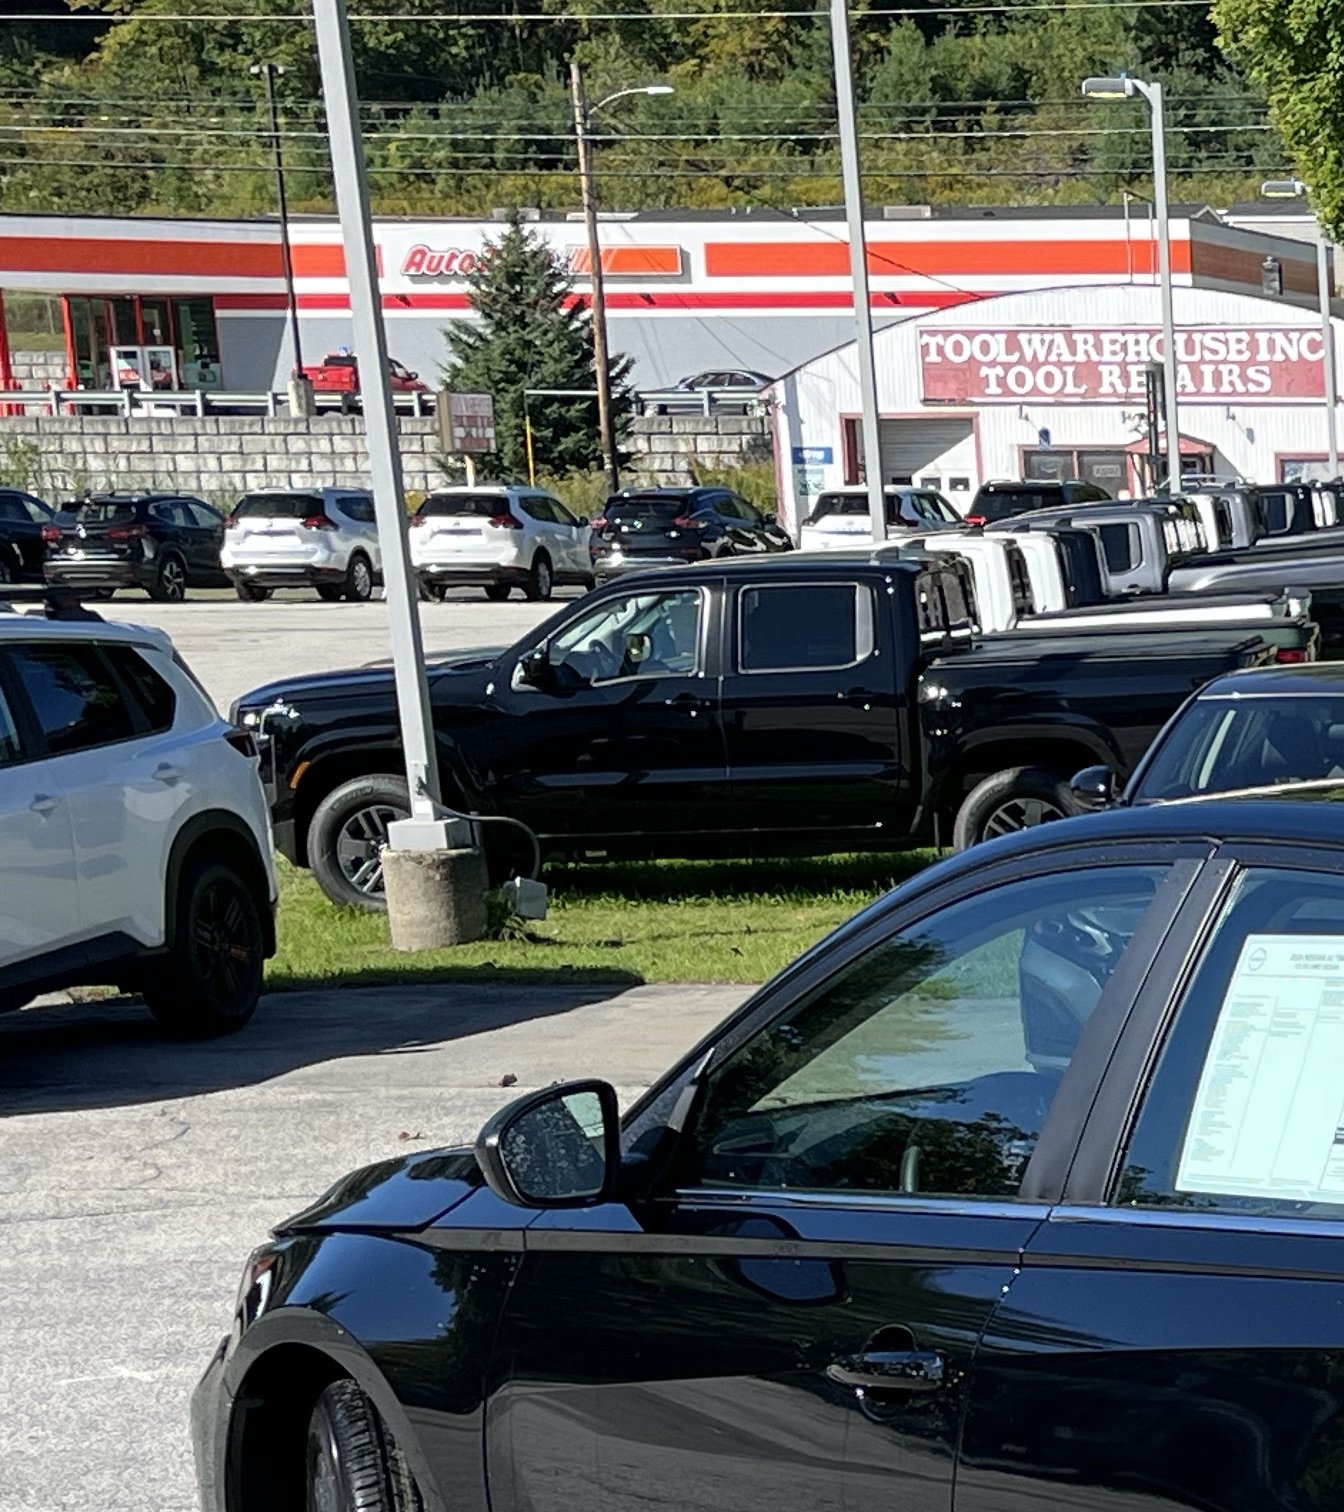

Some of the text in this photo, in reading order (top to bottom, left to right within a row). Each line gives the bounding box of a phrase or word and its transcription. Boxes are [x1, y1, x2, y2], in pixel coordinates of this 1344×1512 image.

[920, 332, 1020, 364] TOOL
[1254, 330, 1326, 362] INC
[979, 363, 1272, 395] TOOL REAIRS
